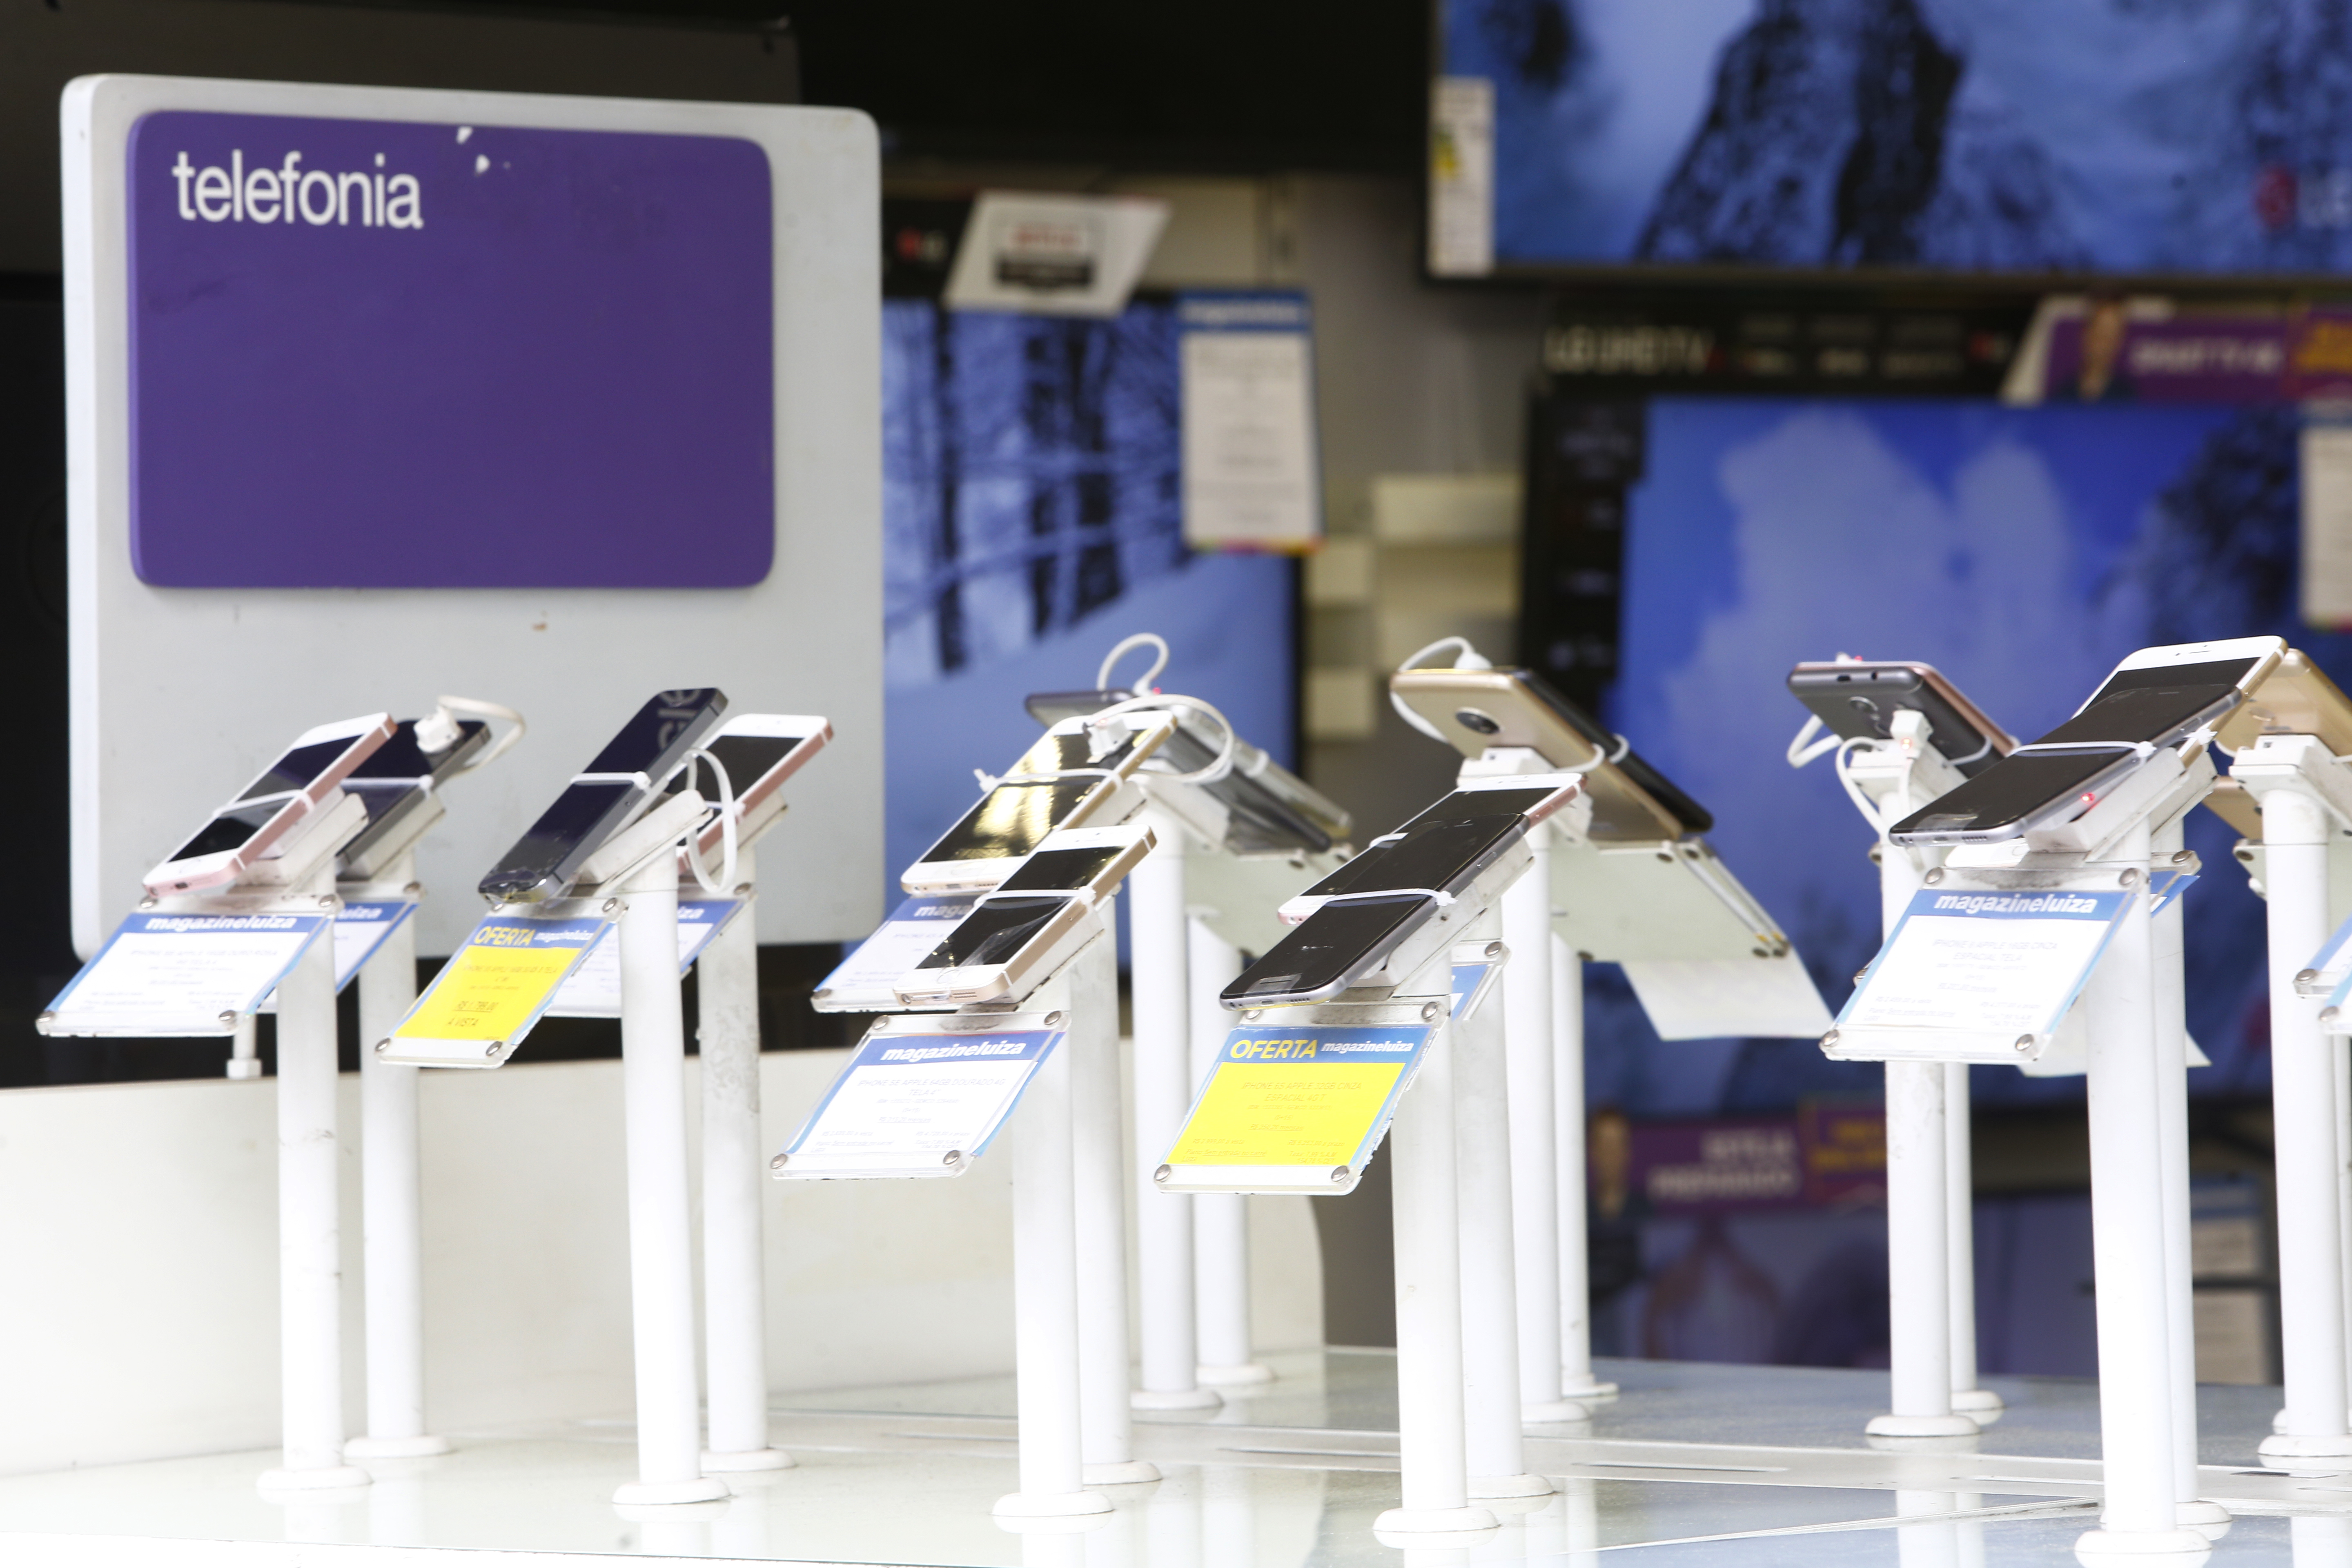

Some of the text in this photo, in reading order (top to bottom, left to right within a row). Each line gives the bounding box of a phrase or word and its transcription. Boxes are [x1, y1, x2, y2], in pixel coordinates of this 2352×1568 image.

[172, 149, 423, 229] telefonia
[1934, 894, 2098, 914] magazineluiza
[145, 915, 297, 932] magazineluiza
[474, 926, 536, 945] OFERTA
[880, 1040, 1026, 1062] magazineluiza
[1230, 1039, 1414, 1059] OFERTA magazineluiza
